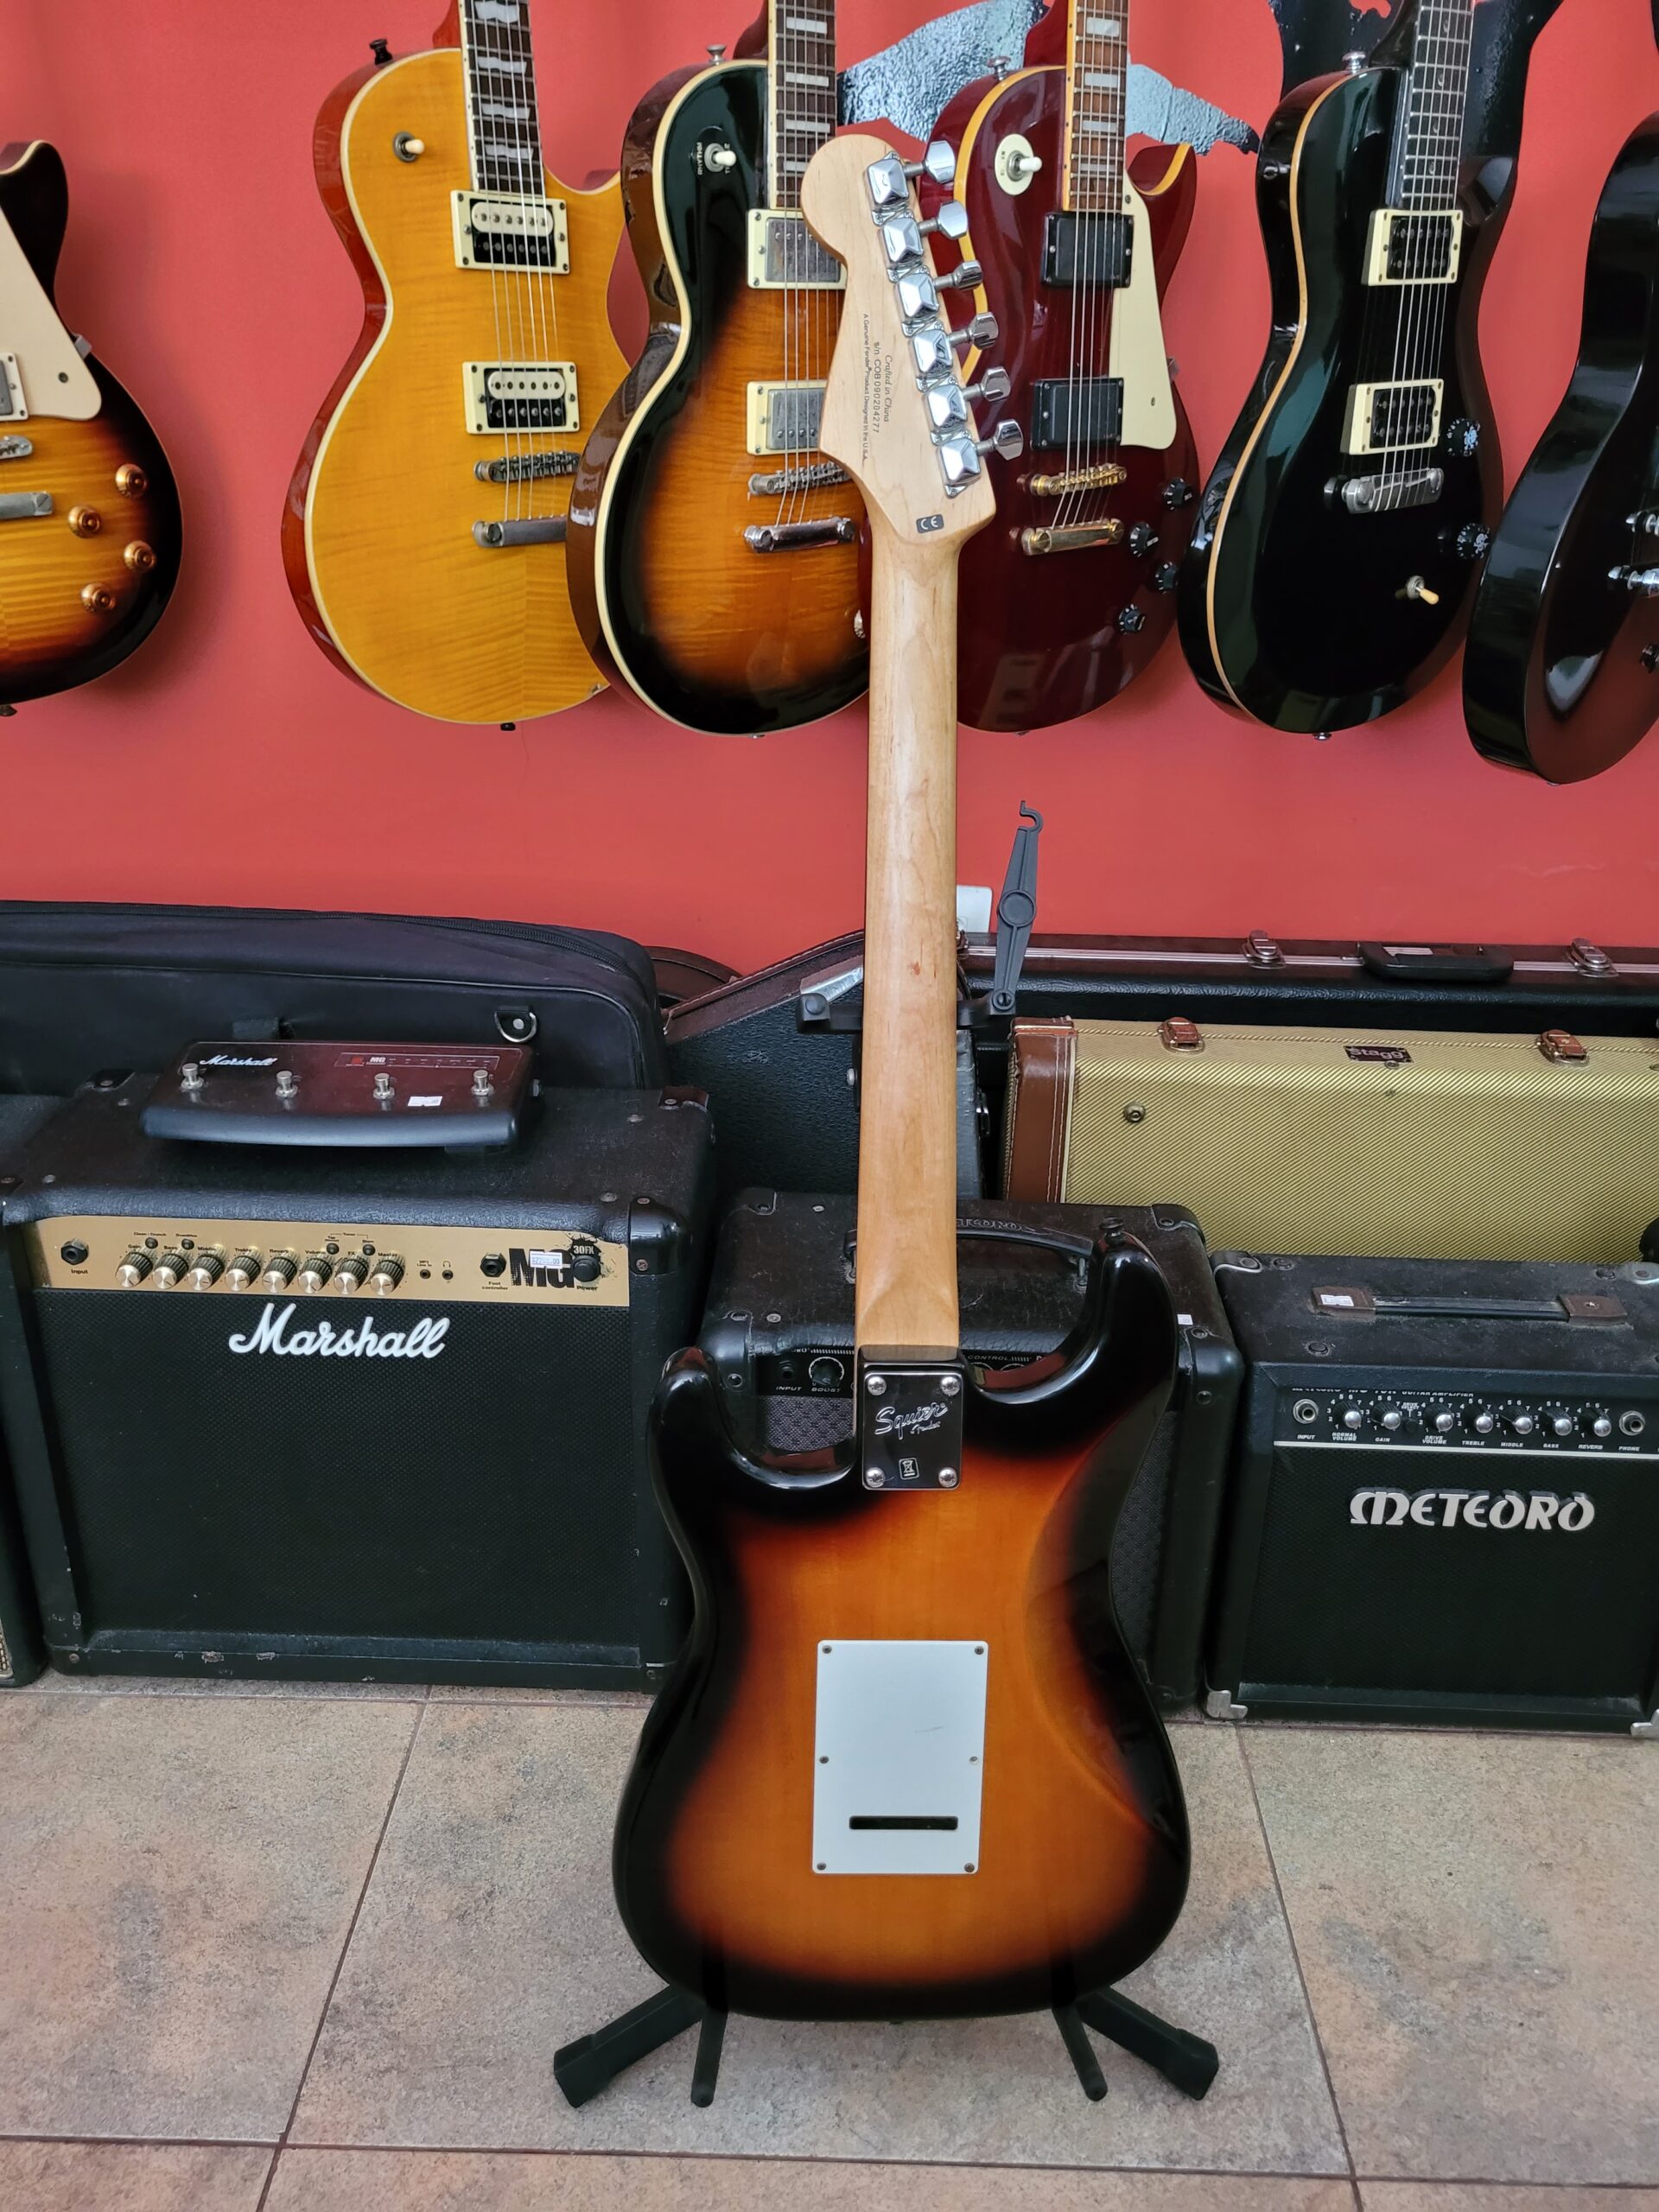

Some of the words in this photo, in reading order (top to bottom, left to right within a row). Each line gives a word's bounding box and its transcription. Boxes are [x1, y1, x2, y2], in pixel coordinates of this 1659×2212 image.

[884, 354, 893, 385] Crafted
[884, 397, 893, 422] China
[920, 516, 939, 530] CE
[199, 1054, 278, 1066] Marshall
[573, 1245, 594, 1254] 30FX
[509, 1248, 575, 1288] MG
[229, 1302, 450, 1358] Marshall
[1350, 1489, 1595, 1531] METEORO
